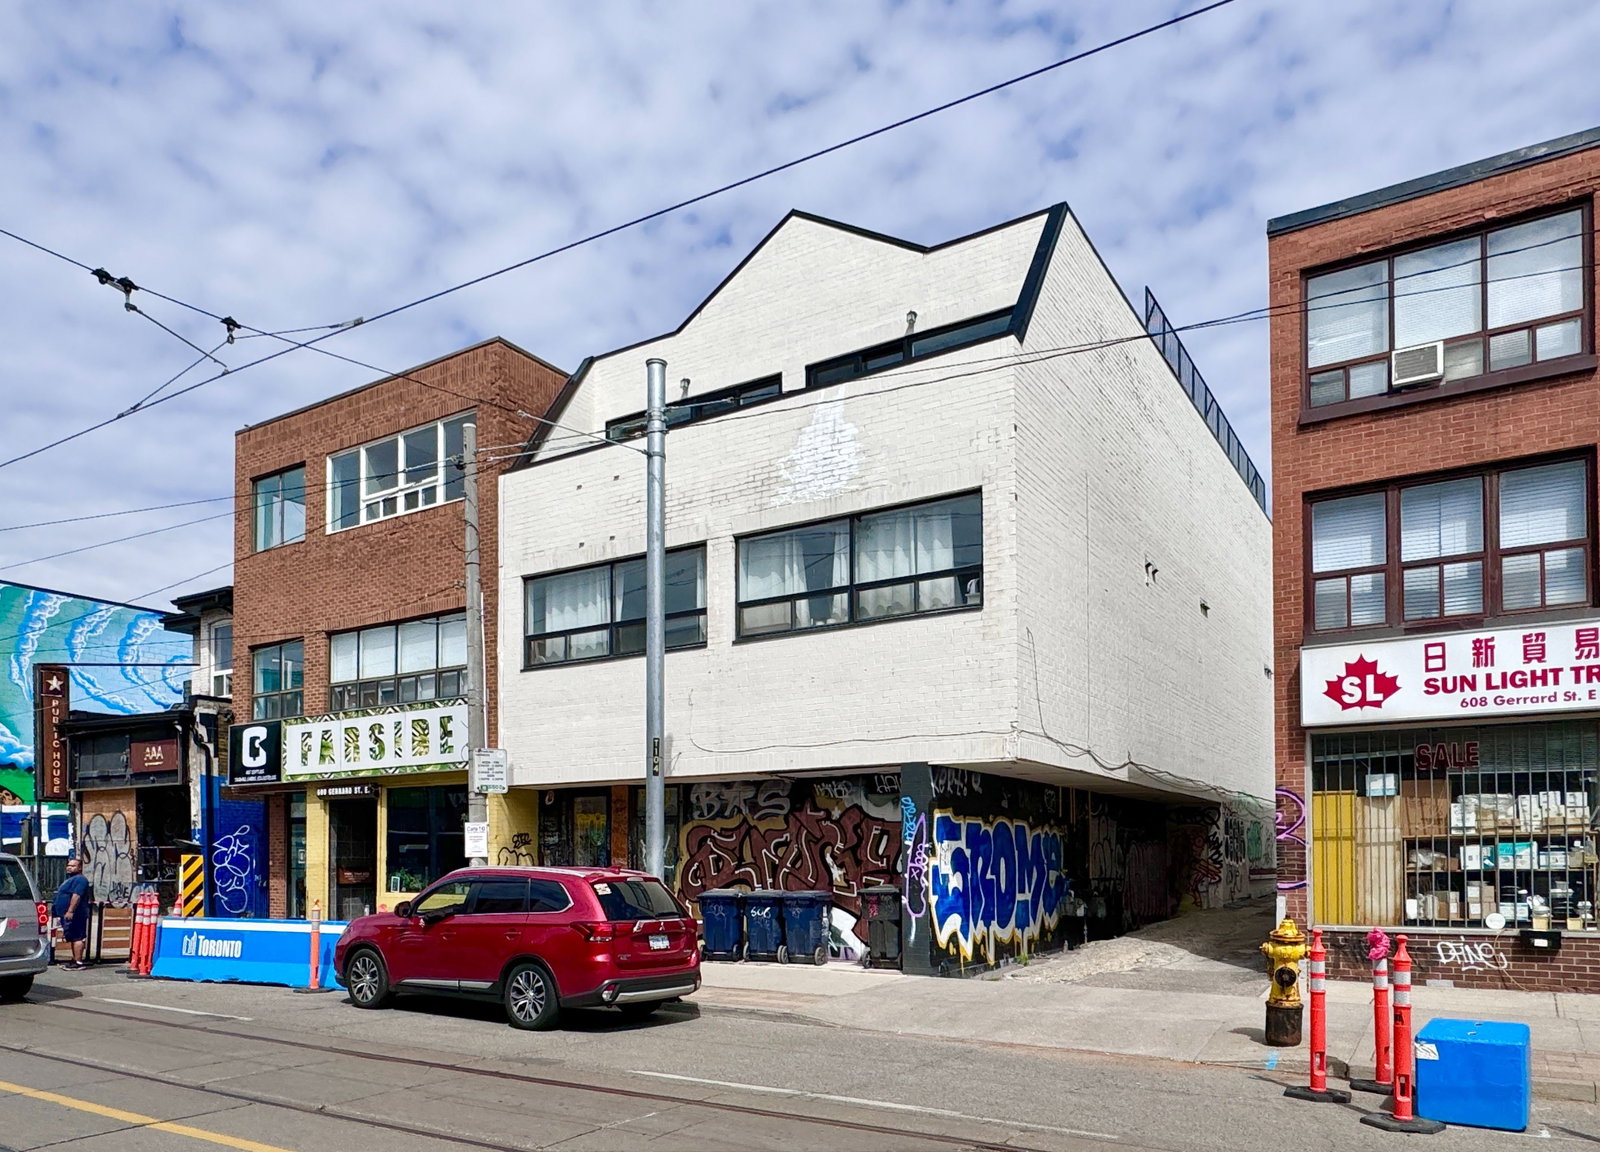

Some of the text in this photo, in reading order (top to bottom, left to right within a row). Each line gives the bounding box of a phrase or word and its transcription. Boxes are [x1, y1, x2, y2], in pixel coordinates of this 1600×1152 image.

[1424, 627, 1600, 673] 日新貿易
[1341, 674, 1384, 704] SL
[1423, 673, 1478, 696] SUN
[1485, 667, 1564, 691] LIGHT
[1460, 696, 1488, 708] 608
[1493, 691, 1558, 706] Gerrard
[1563, 691, 1582, 702] St.
[301, 715, 454, 767] FARSIDE
[1415, 741, 1479, 770] SALE
[52, 751, 61, 794] HOUSE
[197, 935, 243, 958] TORONTO
